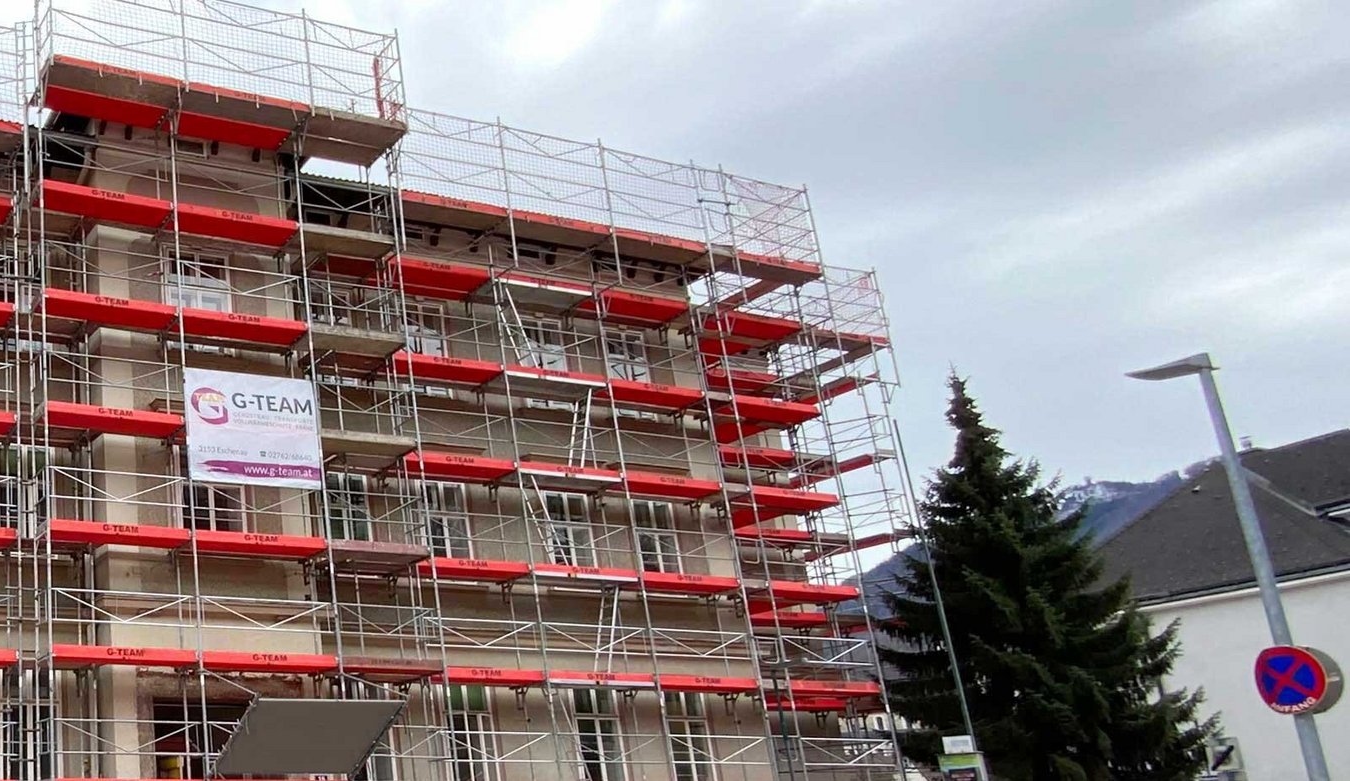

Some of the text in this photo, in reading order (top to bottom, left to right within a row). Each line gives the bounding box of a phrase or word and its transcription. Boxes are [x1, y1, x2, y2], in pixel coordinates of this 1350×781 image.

[92, 189, 125, 200] G-TEAM
[222, 211, 253, 221] G-TEAM
[95, 296, 129, 306] G-TEAM
[228, 314, 260, 322] G-TEAM
[231, 392, 313, 416] G-TEAM
[98, 407, 133, 417] G-TEAM
[446, 456, 474, 464] G-TEAM
[244, 465, 313, 477] www.g-team.at
[102, 524, 139, 534] G-TEAM
[244, 534, 278, 543] G-TEAM
[107, 648, 145, 658] G-TEAM
[252, 653, 287, 663] G-TEAM
[472, 669, 501, 677] G-TEAM
